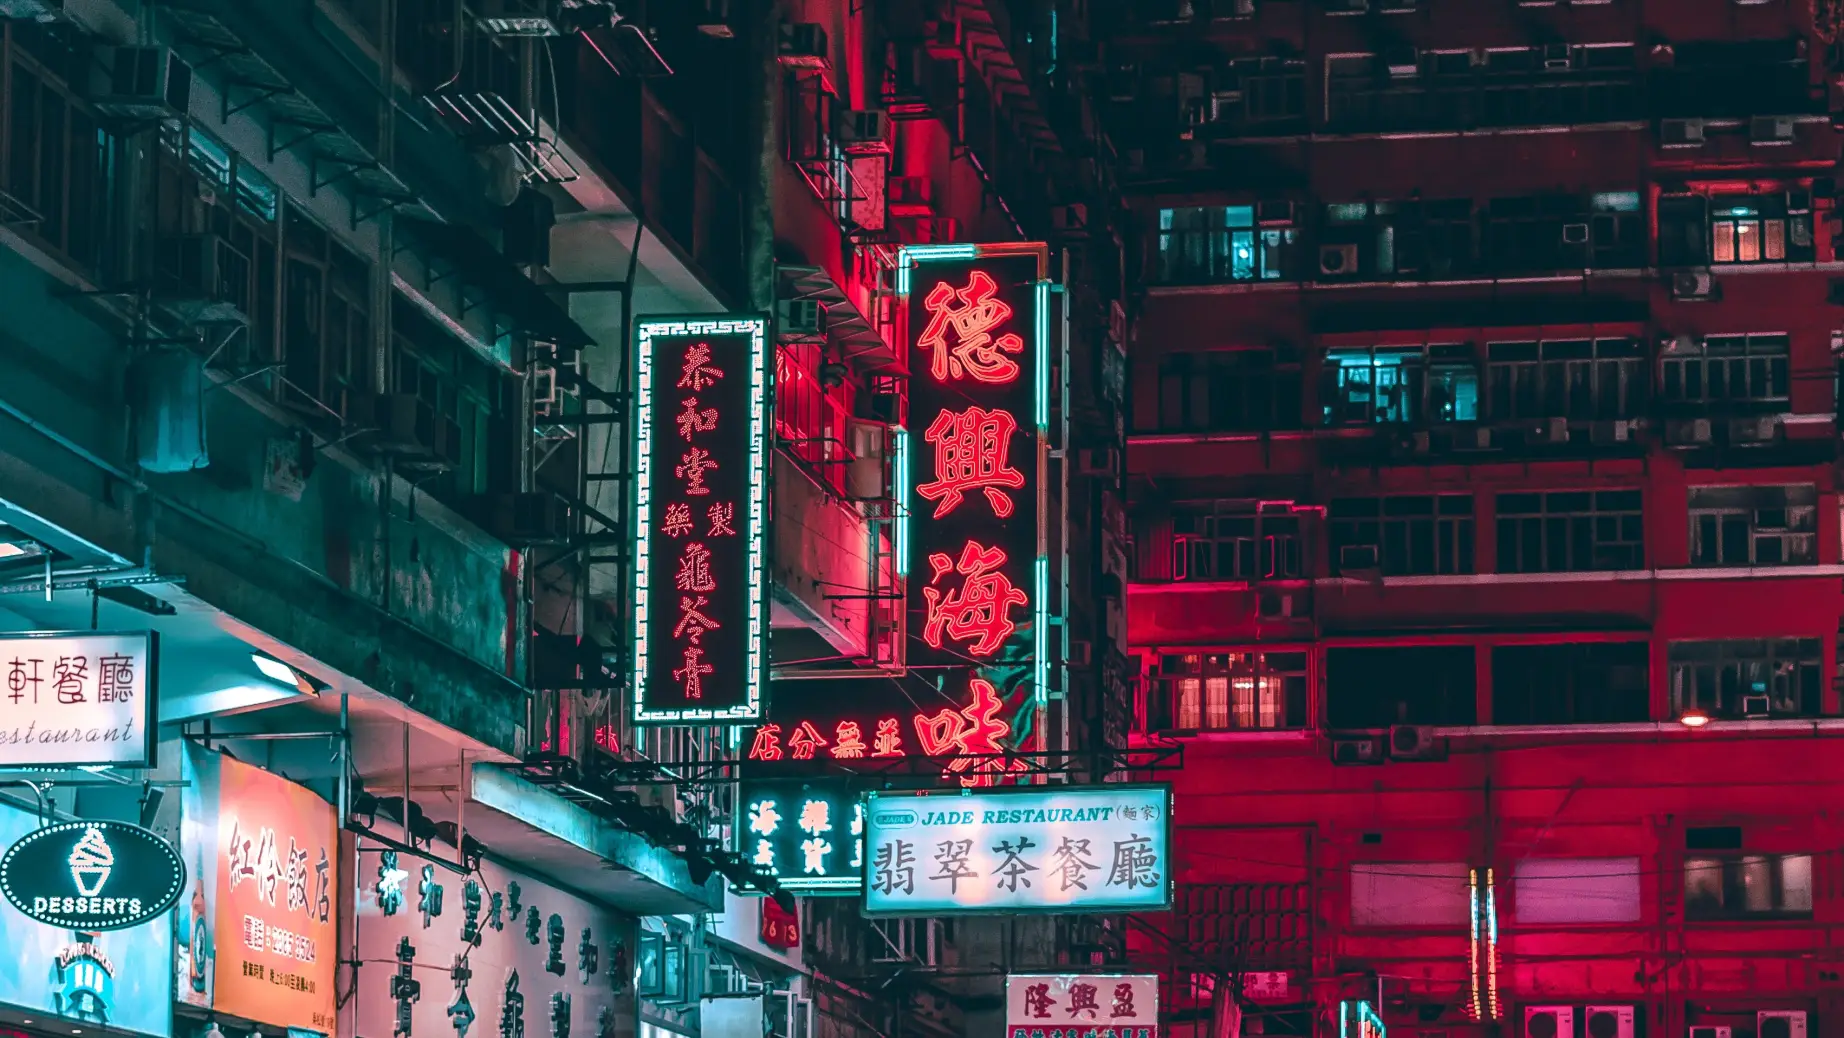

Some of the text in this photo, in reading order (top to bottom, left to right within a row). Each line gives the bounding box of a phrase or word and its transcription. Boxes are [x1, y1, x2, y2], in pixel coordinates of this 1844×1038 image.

[675, 342, 725, 496] 恭和堂
[672, 543, 721, 698] 龜苓膏
[8, 652, 134, 704] 軒餐廳
[921, 810, 975, 826] JADE
[981, 806, 1115, 824] RESTAURANT
[870, 833, 1161, 896] 翡翠茶餐廳
[34, 896, 142, 916] DESSERTS
